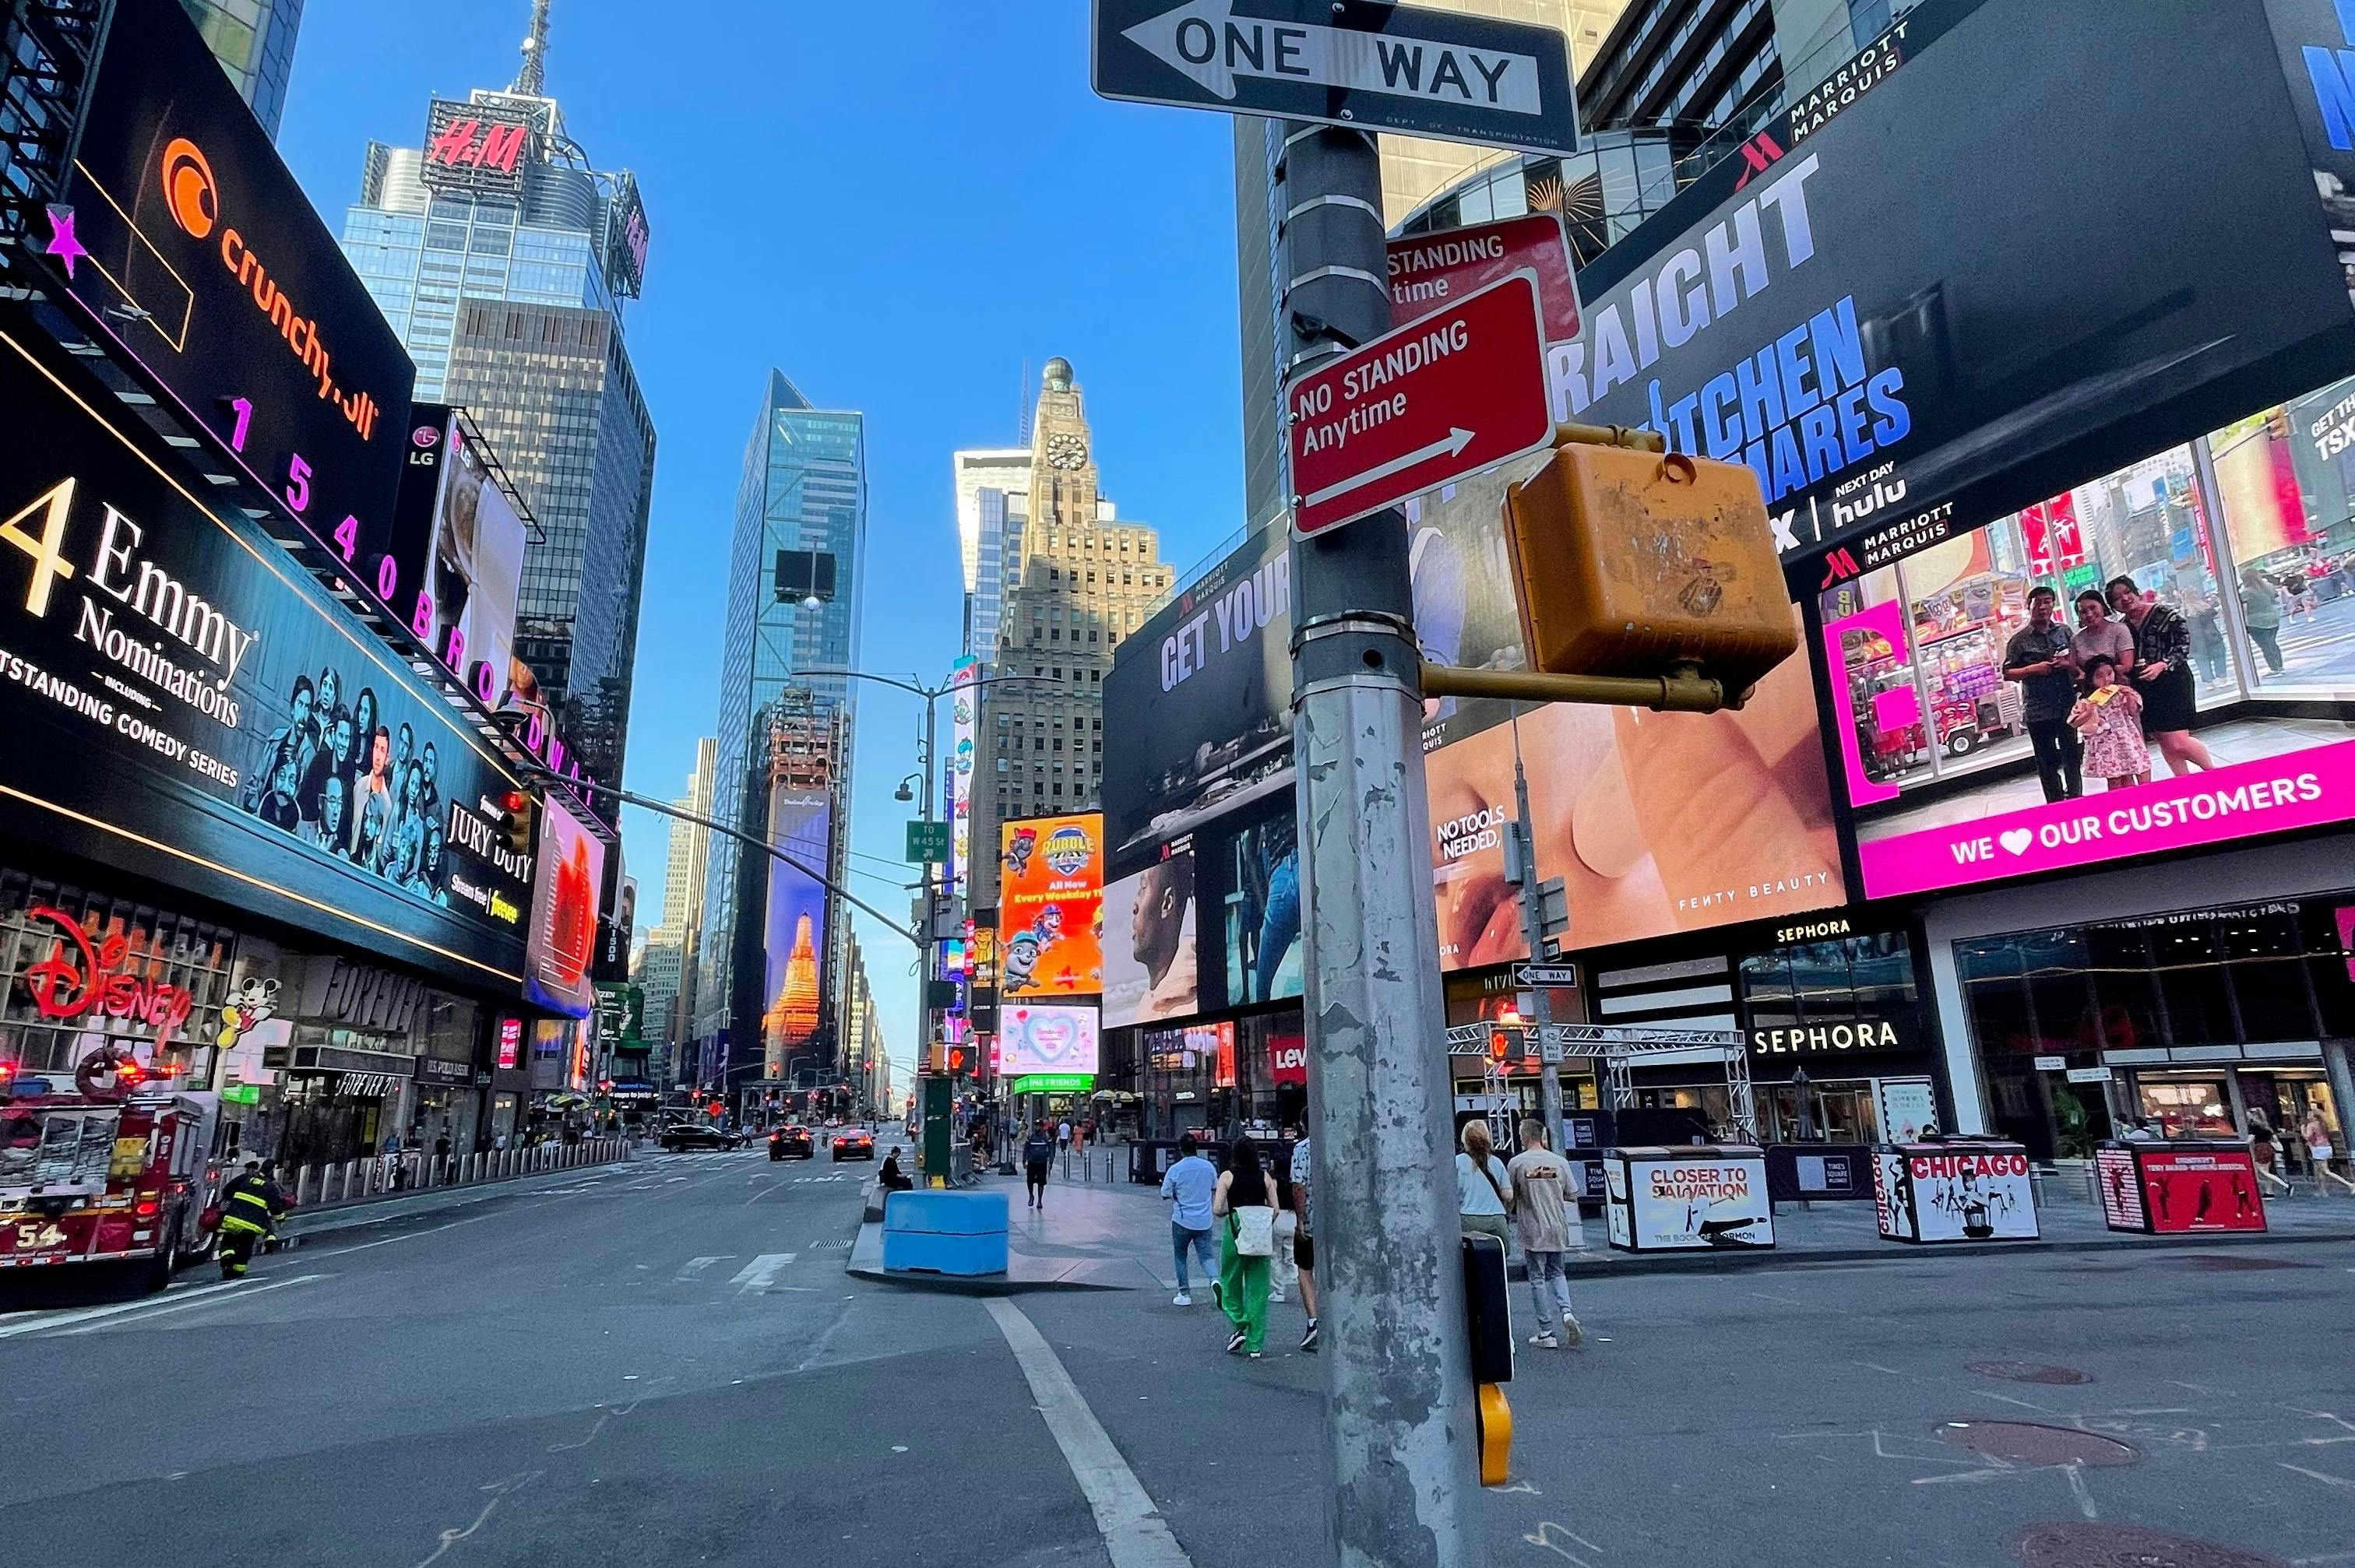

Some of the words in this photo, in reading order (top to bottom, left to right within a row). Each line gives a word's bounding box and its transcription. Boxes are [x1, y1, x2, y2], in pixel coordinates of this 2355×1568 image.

[1175, 17, 1311, 77] ONE
[1376, 40, 1512, 104] WAY
[1791, 20, 1910, 123] MARRIOTT
[1793, 53, 1899, 143] MARQUIS
[429, 118, 526, 174] H&M
[1457, 126, 1558, 146] TRANSPORTATION
[1387, 234, 1505, 276] STANDING
[1392, 276, 1450, 304] time
[1298, 383, 1332, 422] NO
[1343, 319, 1469, 401] STANDING
[1638, 294, 1867, 459] ITCHEN
[1302, 392, 1407, 457] Anytime
[2311, 409, 2336, 438] GET
[410, 451, 434, 466] LG
[1834, 473, 1868, 499] NEXT
[1867, 460, 1896, 486] DAY
[1831, 476, 1908, 529] hulu
[1864, 501, 1954, 550] MARRIOTT
[0, 476, 76, 617] 4
[1865, 522, 1947, 566] MARQUIS
[1195, 561, 1230, 592] MARRIOTT
[1196, 575, 1227, 603] MARQUIS
[1160, 610, 1209, 692] GET
[1214, 549, 1290, 654] YOUR
[74, 595, 241, 729] Nominations
[104, 675, 153, 709] INCLUDING
[117, 712, 188, 762] COMEDY
[188, 748, 239, 788] SERIES
[922, 825, 935, 835] TO
[1437, 820, 1461, 843] NO
[1459, 805, 1505, 833] TOOLS
[1950, 837, 1994, 866] WE
[2039, 815, 2103, 849] OUR
[2107, 772, 2322, 837] CUSTOMERS
[447, 803, 493, 857] JURY
[493, 834, 533, 884] DUTY
[921, 837, 934, 846] 45
[935, 838, 945, 846] St
[1442, 831, 1502, 860] NEEDED,
[1014, 893, 1044, 905] Every
[1045, 889, 1092, 902] Weekday
[1049, 881, 1063, 891] All
[1065, 881, 1087, 889] New
[1678, 888, 1737, 911] FENTY
[1748, 870, 1830, 898] BEAUTY
[1776, 919, 1850, 944] SEPHORA
[1522, 970, 1540, 980] ONE
[1548, 972, 1568, 980] WAY
[1754, 1021, 1899, 1054] SEPHORA
[335, 1071, 382, 1096] FOREVER
[1045, 1078, 1081, 1087] FRIENDS
[1650, 1169, 1720, 1184] CLOSER
[1723, 1168, 1747, 1182] TO
[1910, 1153, 2029, 1180] CHICAGO
[1652, 1183, 1748, 1199] SALVATION
[1872, 1153, 1889, 1233] CHICAGO
[16, 1223, 65, 1248] 54
